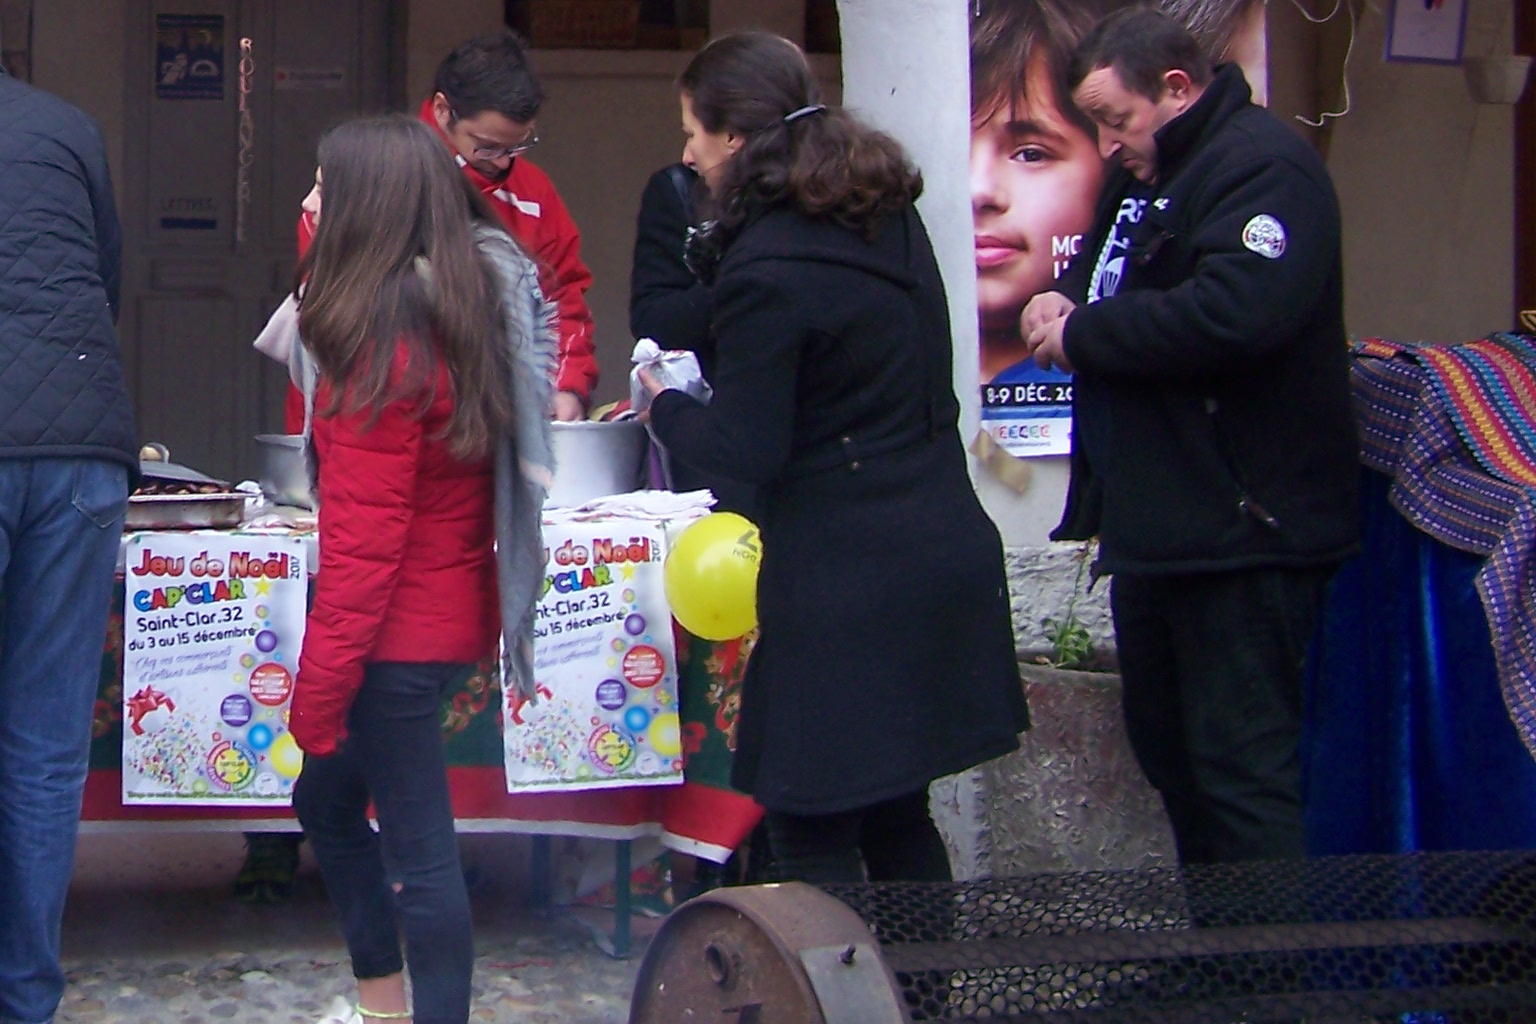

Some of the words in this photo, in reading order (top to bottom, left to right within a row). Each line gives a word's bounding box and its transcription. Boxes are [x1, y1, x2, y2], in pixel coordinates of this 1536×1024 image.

[1014, 382, 1052, 403] DÉC.
[1055, 386, 1073, 402] 20
[132, 549, 184, 577] Jeu
[189, 551, 224, 578] de
[228, 552, 289, 580] Noël
[554, 539, 589, 566] de
[593, 537, 651, 564] Noël
[290, 556, 301, 580] 2017
[133, 578, 247, 612] CAP'CLAR
[549, 621, 562, 635] 15
[565, 609, 626, 632] décembre
[128, 639, 145, 651] du
[147, 636, 156, 649] 3
[158, 635, 175, 647] au
[177, 632, 190, 645] 15
[193, 626, 256, 644] décembre
